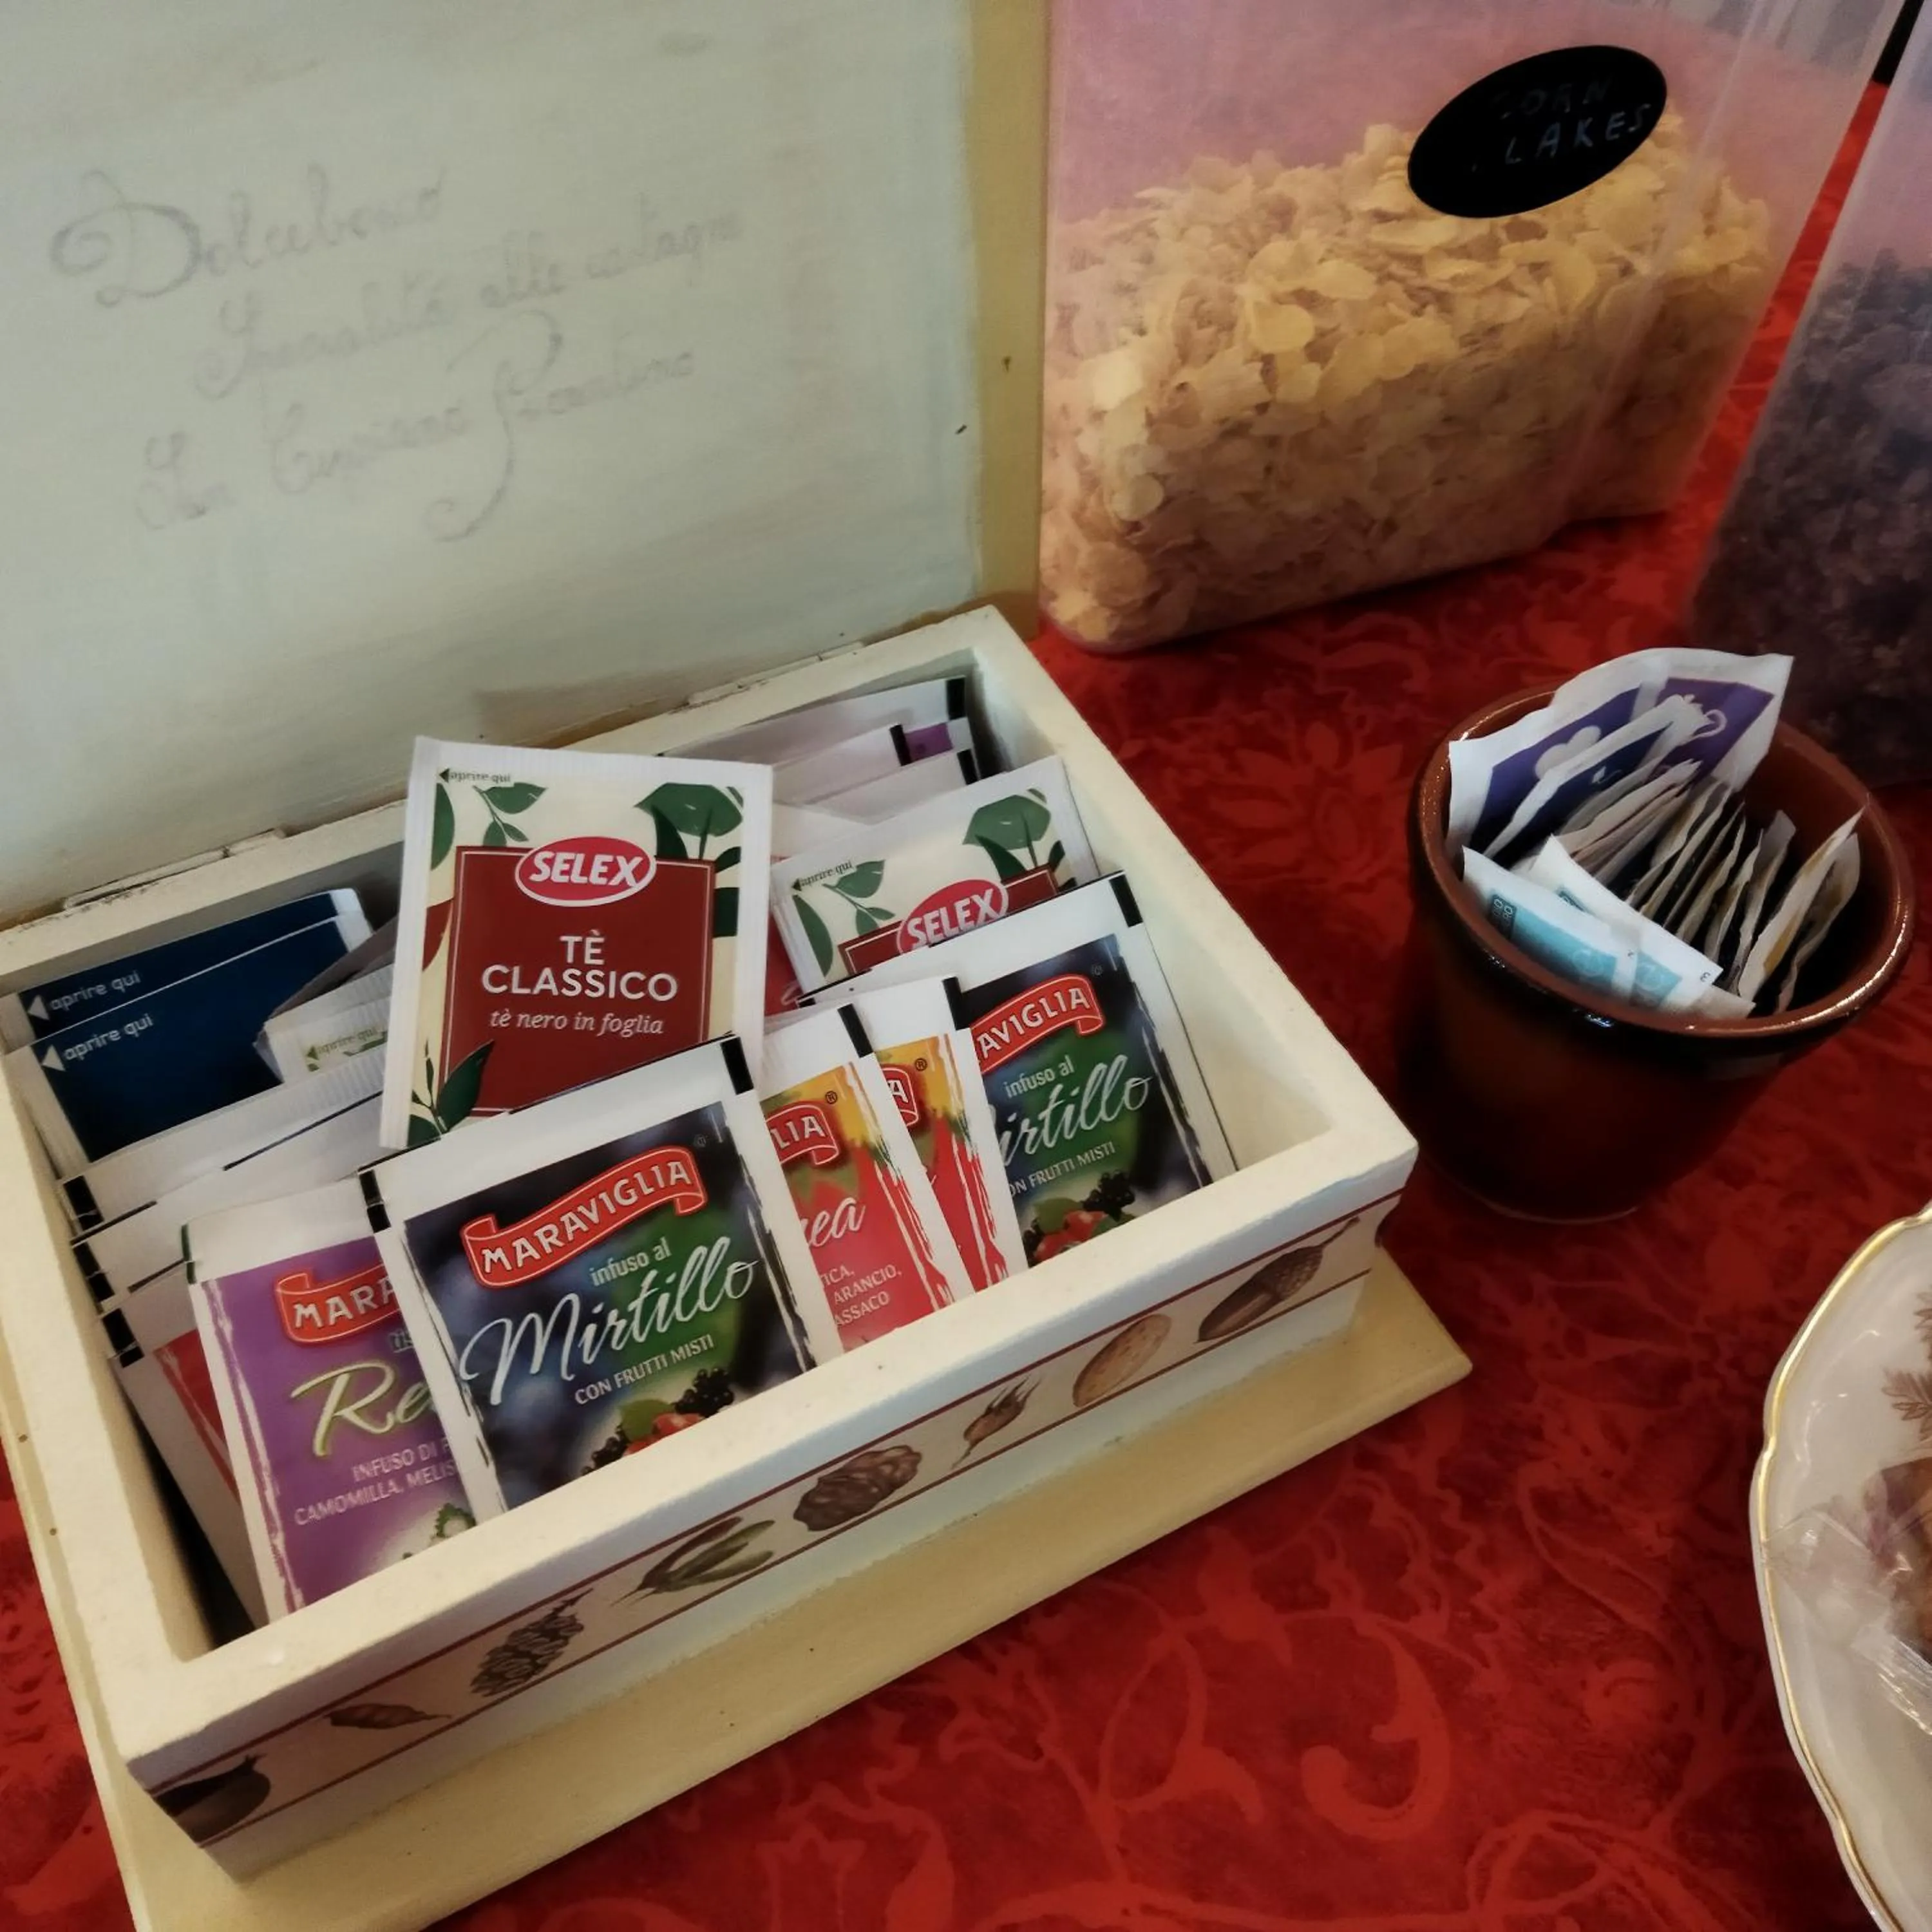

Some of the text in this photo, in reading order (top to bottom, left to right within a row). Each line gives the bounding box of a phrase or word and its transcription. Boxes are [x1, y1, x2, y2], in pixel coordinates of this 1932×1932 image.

[1472, 103, 1651, 172] LAKES
[491, 774, 511, 783] qui
[529, 851, 644, 888] SELEX
[907, 888, 996, 949] SELEX
[559, 929, 605, 966] TÈ
[50, 970, 142, 1011] aprire qui
[481, 965, 678, 1002] CLASSICO
[64, 1012, 154, 1061] aprire qui
[490, 1008, 665, 1037] tè nero in foglia
[1003, 1054, 1075, 1099] infuso al
[990, 1054, 1153, 1166] irtillo
[1028, 1158, 1075, 1188] FRUTTI
[1076, 1141, 1117, 1166] MISTI
[480, 1160, 692, 1274] MARAVIGLIA
[801, 1197, 866, 1247] ea
[589, 1237, 672, 1287] infuso al
[459, 1236, 759, 1406] Mirtillo
[574, 1334, 715, 1406] CON FRUTTI MISTI
[352, 1448, 415, 1482] INFUSO
[419, 1442, 437, 1462] DI
